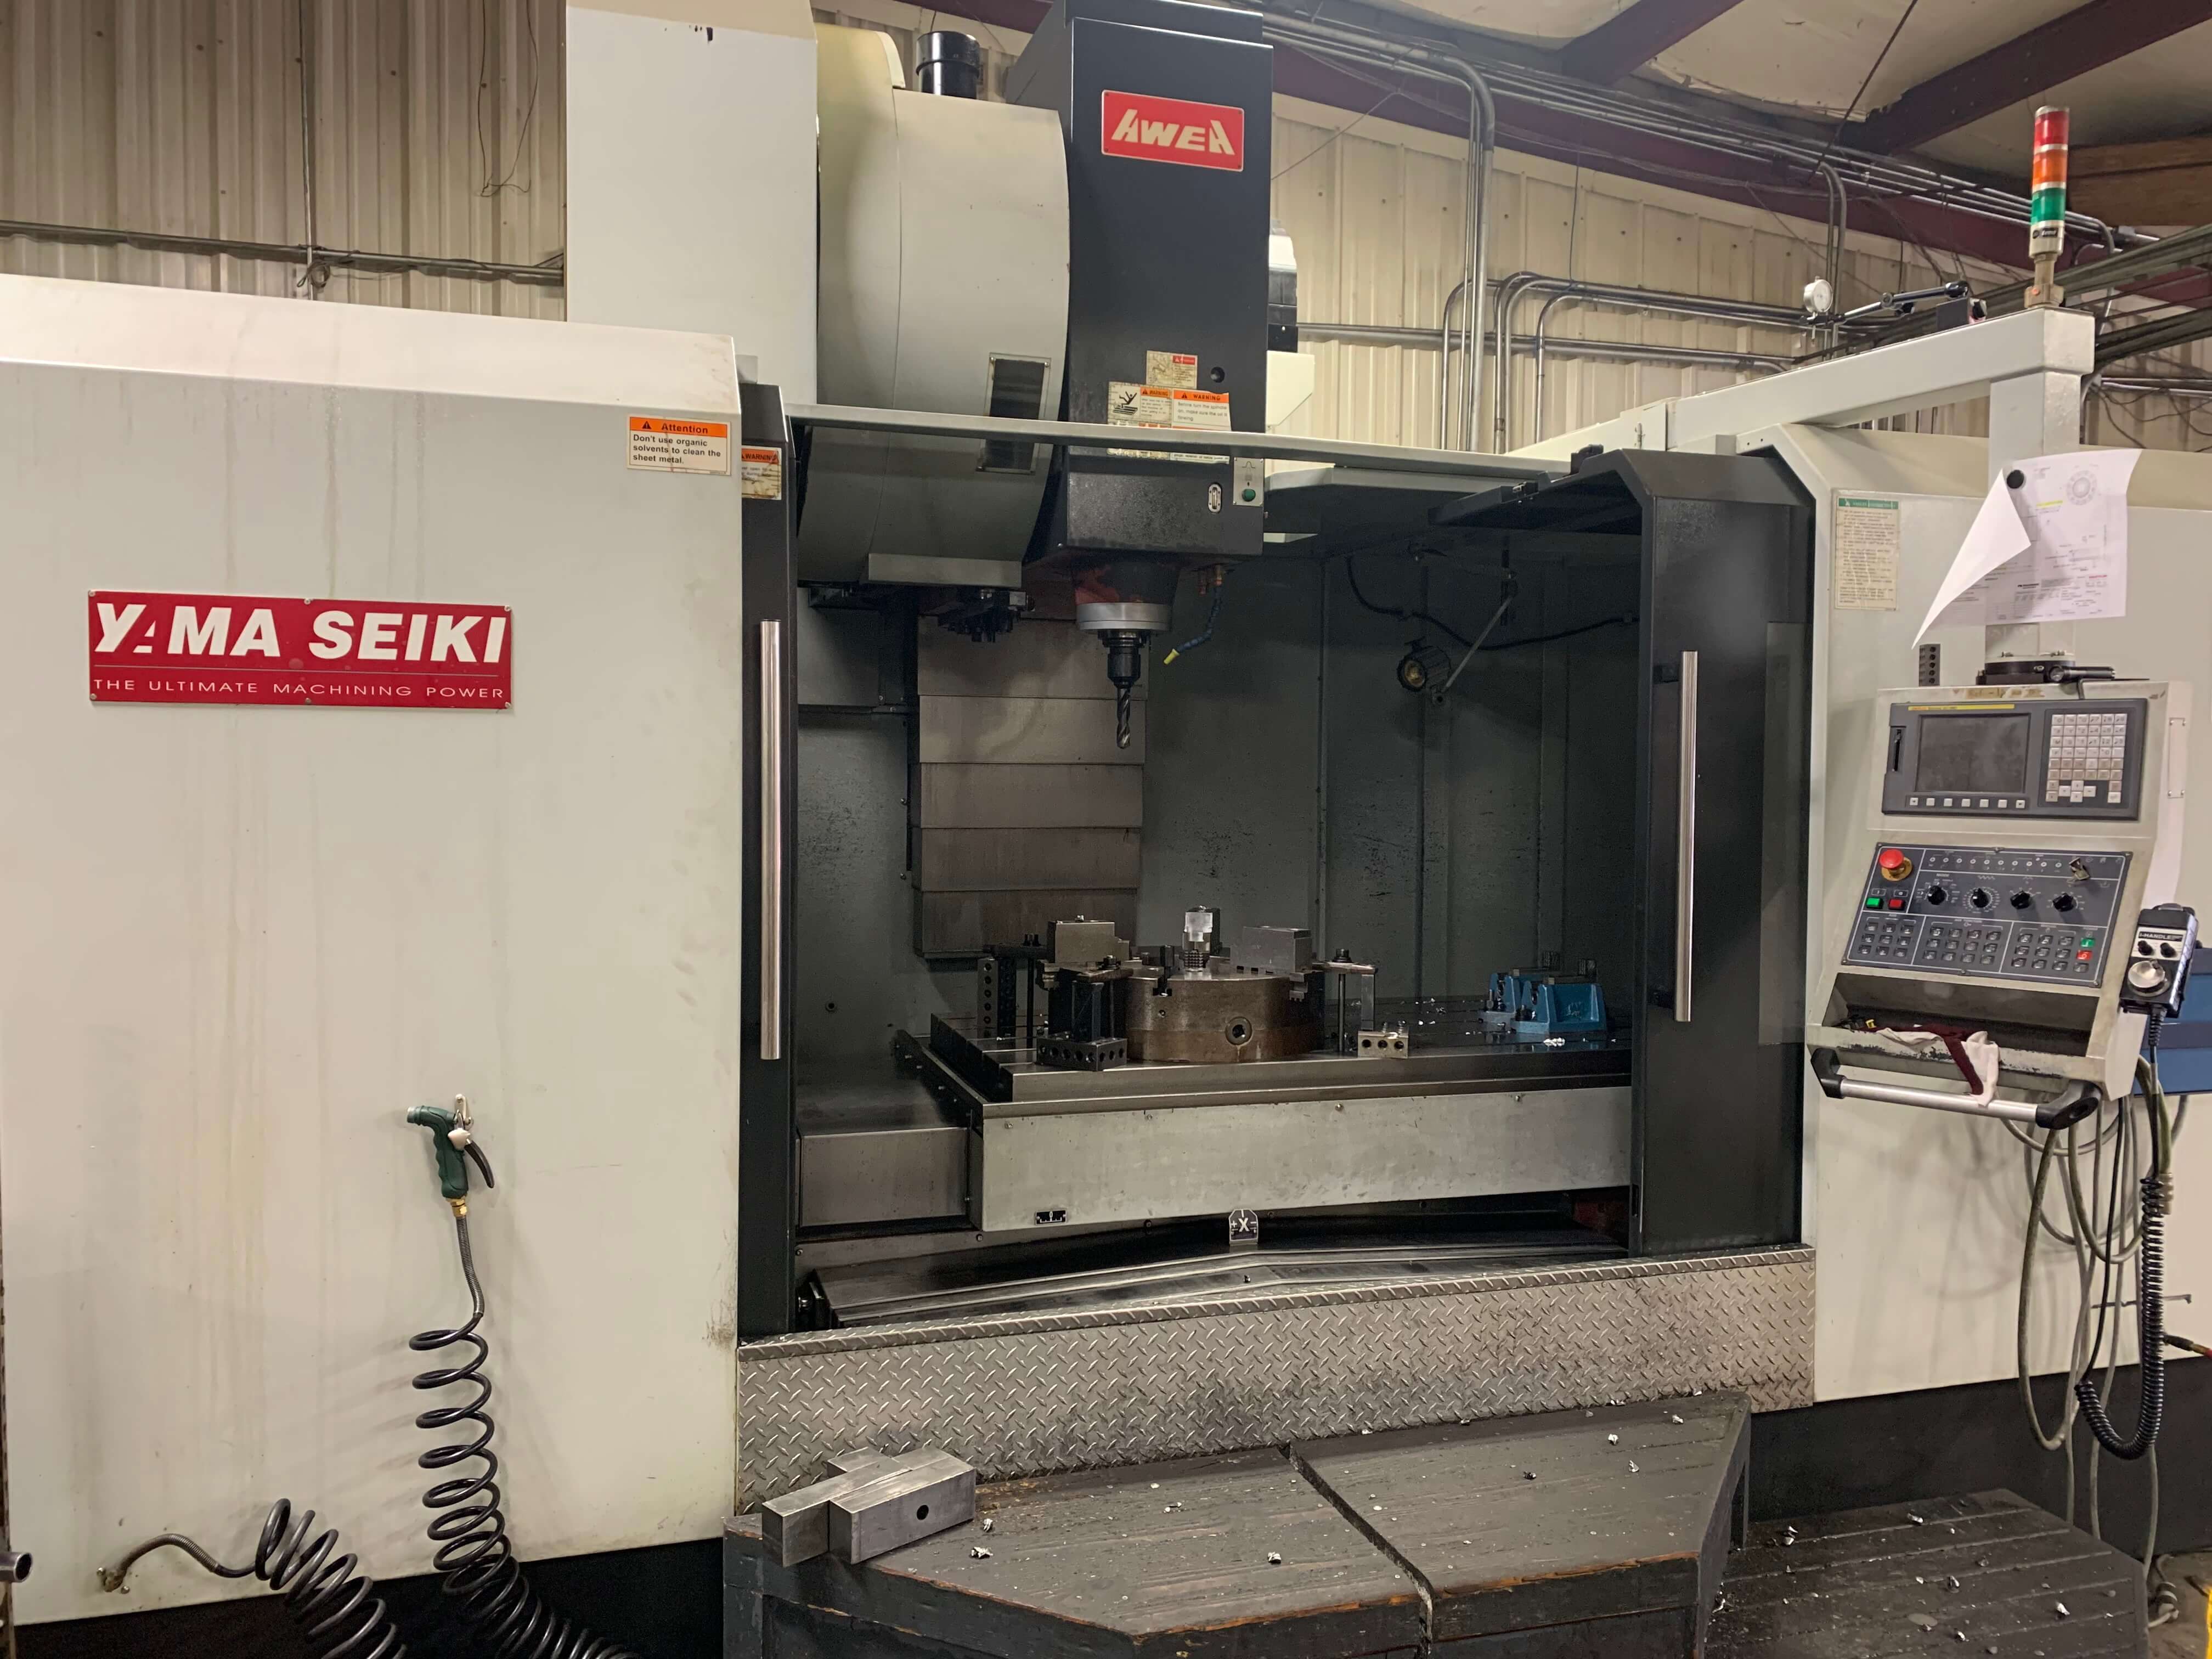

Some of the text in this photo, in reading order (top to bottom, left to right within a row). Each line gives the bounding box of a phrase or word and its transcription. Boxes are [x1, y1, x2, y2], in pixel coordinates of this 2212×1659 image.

[1111, 109, 1235, 155] AWEA
[662, 423, 708, 434] Attention
[633, 434, 656, 443] Don't
[659, 456, 684, 464] metal.
[95, 602, 506, 663] YAMA SEIKI
[94, 679, 504, 698] THE ULTIMATE MACHINING POWER
